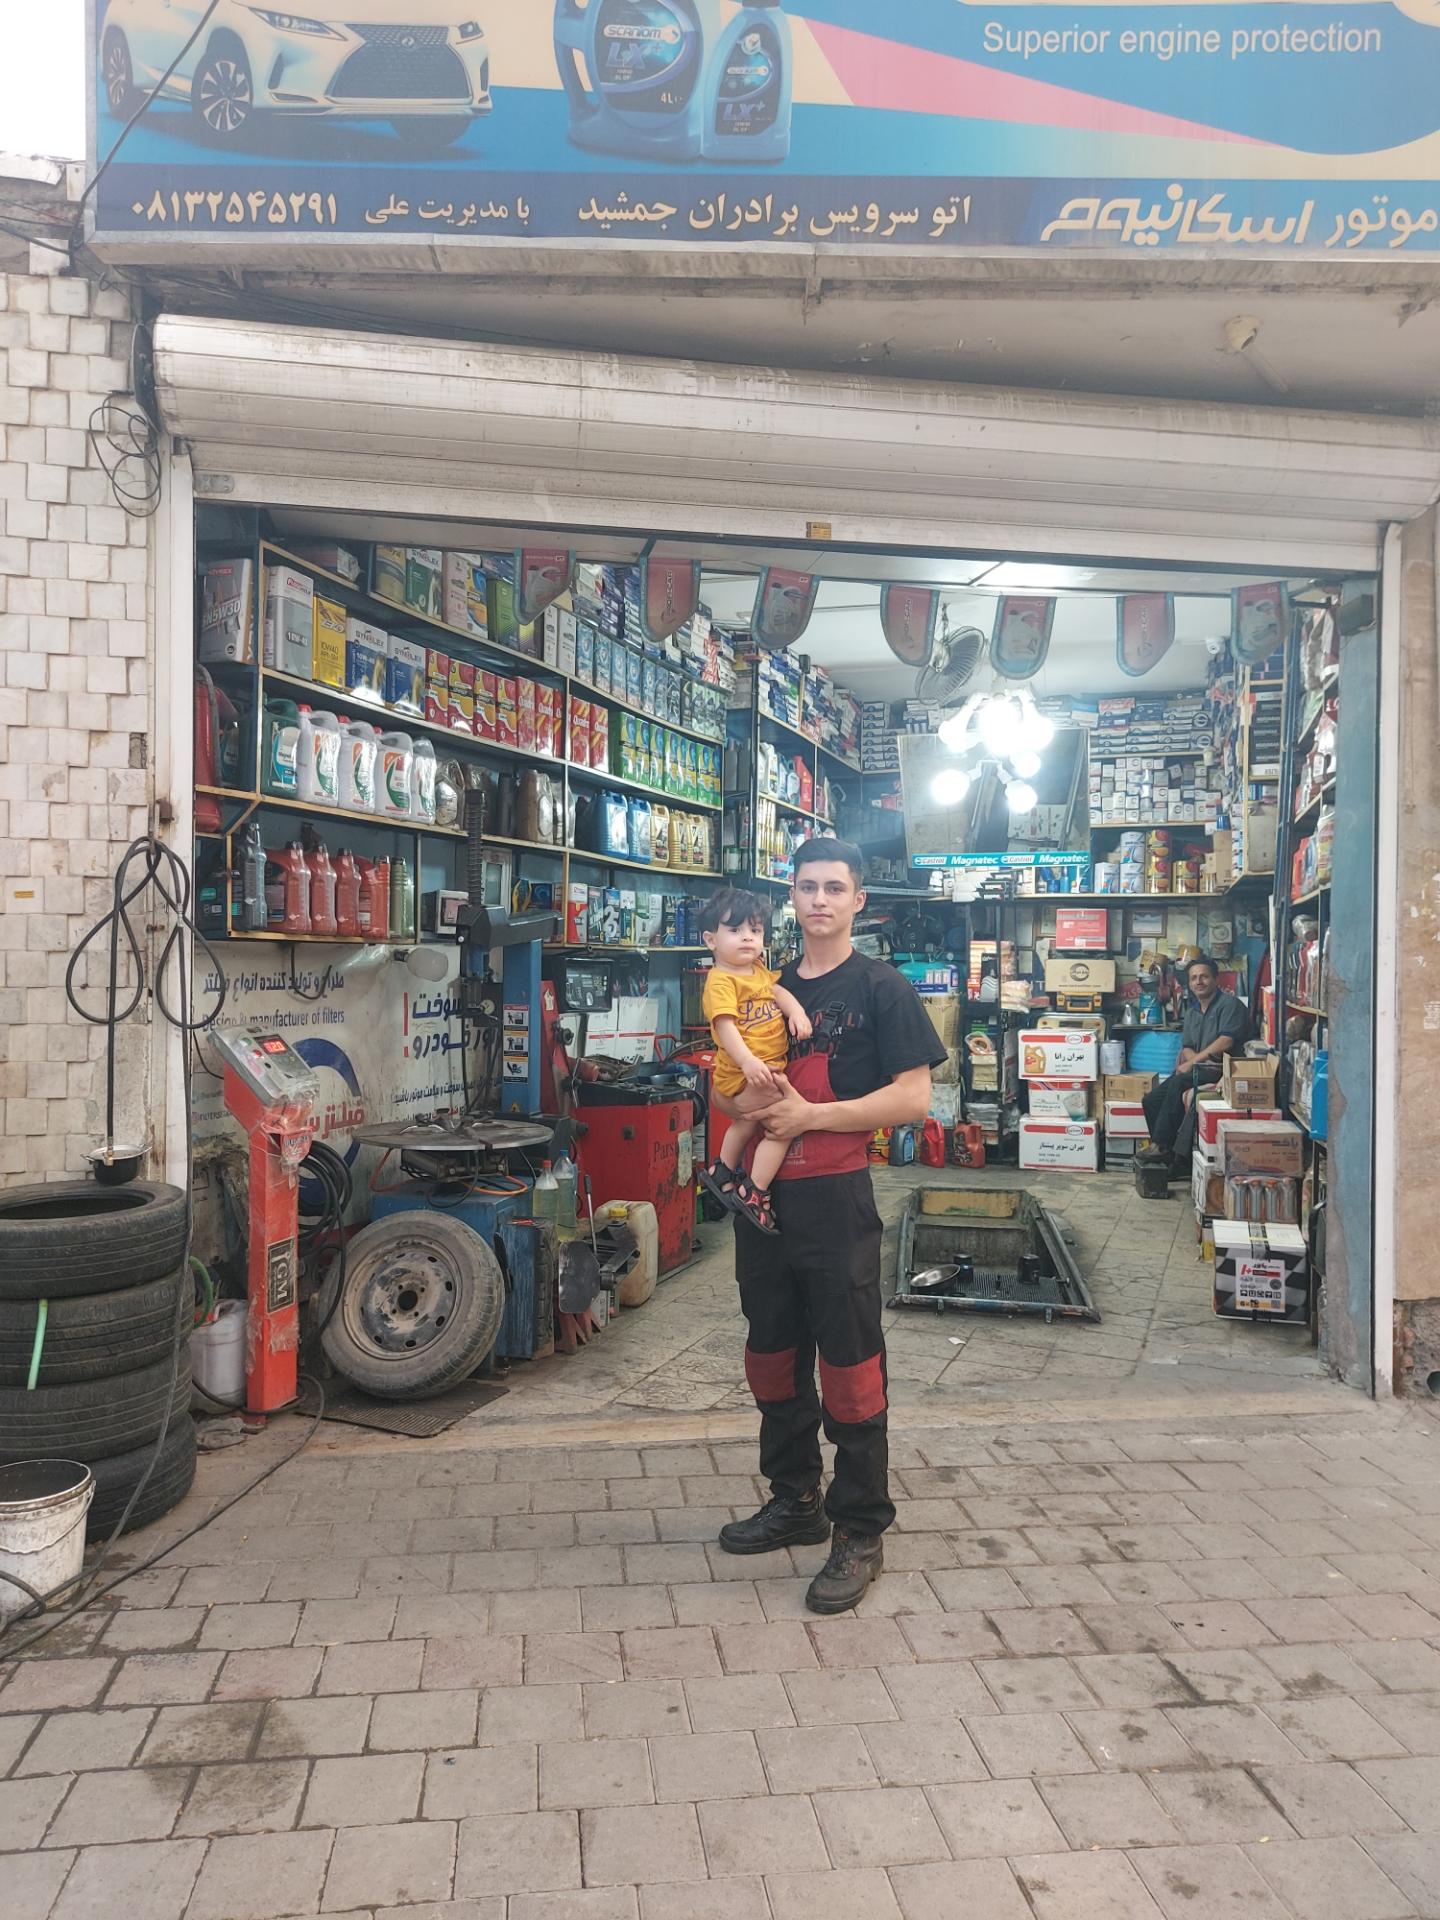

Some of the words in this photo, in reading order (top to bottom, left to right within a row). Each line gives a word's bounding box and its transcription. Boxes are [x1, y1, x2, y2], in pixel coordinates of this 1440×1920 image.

[983, 22, 1110, 60] Superior
[1119, 23, 1221, 61] engine
[1232, 23, 1381, 60] protection
[131, 190, 337, 225] ۰۸۱۳۲۵۴۵۲۹۱
[365, 193, 410, 224] علی
[418, 198, 509, 227] مدیریت
[516, 196, 530, 226] با
[578, 191, 678, 230] جمشید
[688, 193, 799, 235] برادران
[809, 201, 919, 236] سرویس
[928, 194, 972, 237] اتو
[1040, 184, 1315, 246] اسکانیوم
[1324, 194, 1439, 248] موتور
[951, 856, 999, 866] Magnatec
[1039, 854, 1088, 864] Magnatec
[203, 972, 230, 997] فلتر
[312, 1007, 320, 1024] of
[323, 1006, 344, 1024] filters
